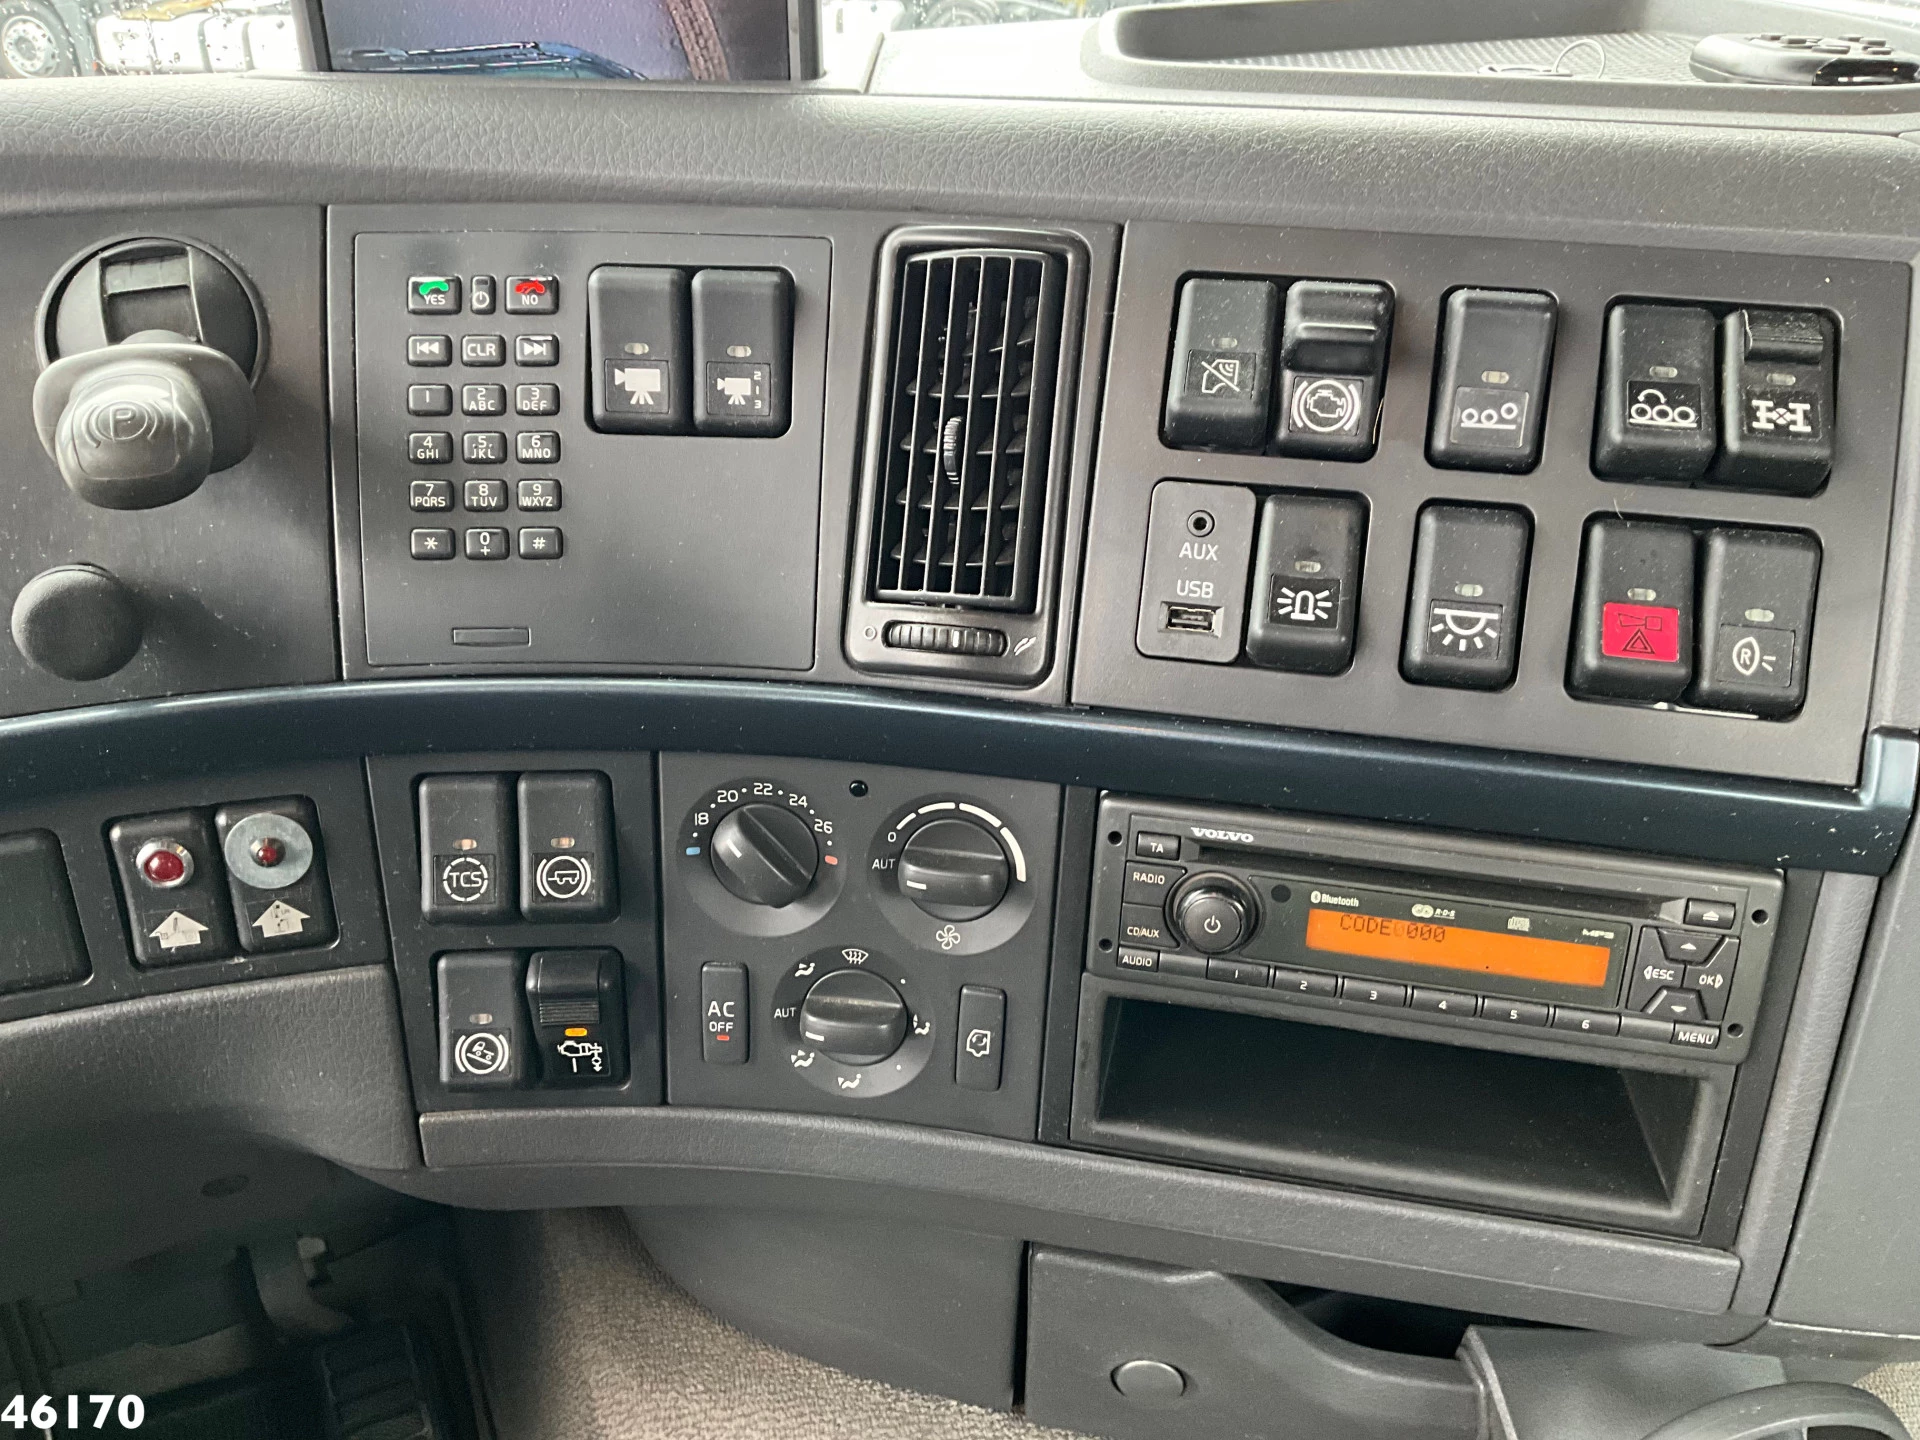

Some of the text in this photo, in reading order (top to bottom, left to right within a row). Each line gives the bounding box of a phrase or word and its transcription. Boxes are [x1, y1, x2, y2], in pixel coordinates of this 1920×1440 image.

[424, 295, 445, 305] YES
[522, 295, 538, 305] NO
[468, 343, 496, 356] CLR
[754, 371, 761, 380] 2
[477, 388, 486, 400] 2
[531, 388, 540, 400] 3
[469, 401, 496, 411] ABC
[522, 401, 548, 411] DEF
[754, 400, 762, 409] 3
[110, 405, 136, 441] P
[423, 436, 433, 448] 4
[478, 436, 487, 448] 5
[531, 435, 541, 448] 6
[417, 449, 439, 459] GHI
[471, 449, 496, 459] JKL
[522, 448, 551, 459] MNO
[425, 484, 435, 496] 7
[478, 484, 489, 496] 8
[532, 484, 542, 496] 9
[415, 497, 446, 507] PQRS
[471, 497, 498, 507] TUV
[521, 497, 553, 507] WXYZ
[480, 532, 490, 545] 0
[532, 537, 546, 550] #
[1179, 542, 1218, 561] AUX
[1176, 579, 1214, 598] USB
[1740, 649, 1751, 665] R
[753, 783, 773, 796] 22
[717, 790, 739, 803] 20
[789, 793, 808, 808] 24
[694, 812, 709, 826] 18
[814, 819, 833, 834] 26
[1190, 827, 1254, 843] VOLVO
[1150, 842, 1164, 853] TA
[872, 858, 895, 870] AUT
[450, 871, 483, 888] TCS
[1133, 872, 1165, 885] RADIO
[1321, 893, 1359, 907] Bluetooth
[1340, 914, 1392, 936] CODE
[1127, 926, 1159, 938] CD/AUX
[1582, 928, 1614, 939] MP3
[1122, 955, 1152, 967] AUDIO
[1652, 968, 1675, 981] ESC
[1699, 974, 1715, 986] OK
[1300, 981, 1308, 990] 2
[1370, 990, 1378, 1000] 3
[707, 1000, 735, 1018] AC
[1438, 1001, 1447, 1010] 4
[774, 1007, 796, 1019] AUT
[1510, 1010, 1518, 1020] 5
[709, 1021, 734, 1033] OFF
[1582, 1019, 1590, 1030] 6
[1678, 1031, 1715, 1045] MENU
